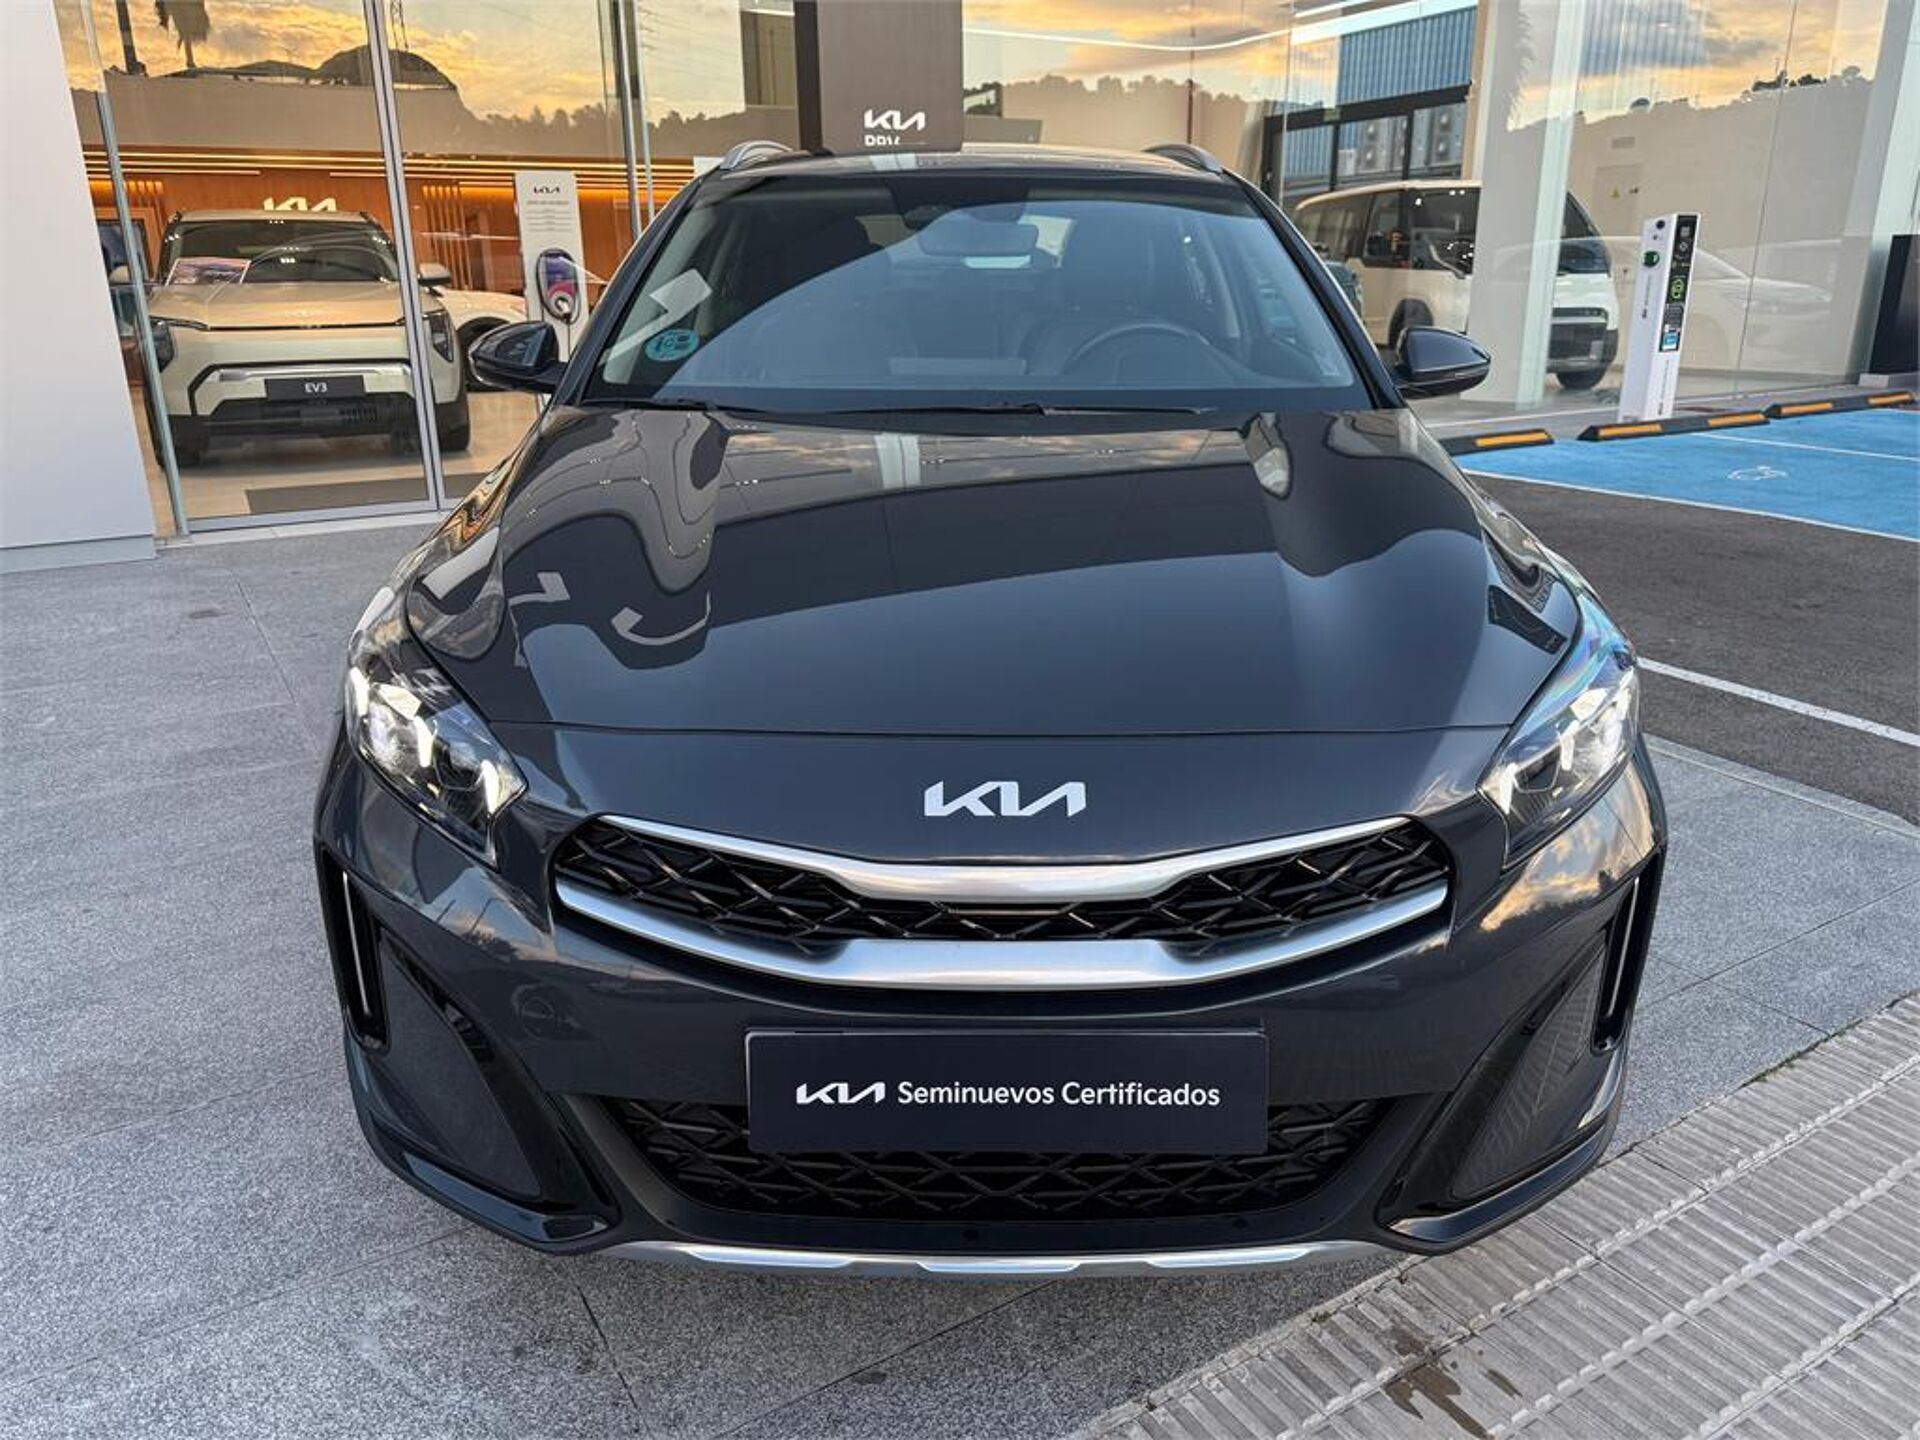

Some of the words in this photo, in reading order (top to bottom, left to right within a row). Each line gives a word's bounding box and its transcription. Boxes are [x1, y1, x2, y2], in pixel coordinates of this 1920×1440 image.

[863, 109, 926, 131] KIA
[305, 382, 327, 393] EV3
[924, 781, 1086, 817] KIA
[796, 1082, 886, 1104] KIA
[898, 1081, 1055, 1104] Seminuevos
[1061, 1081, 1220, 1105] Certificados
